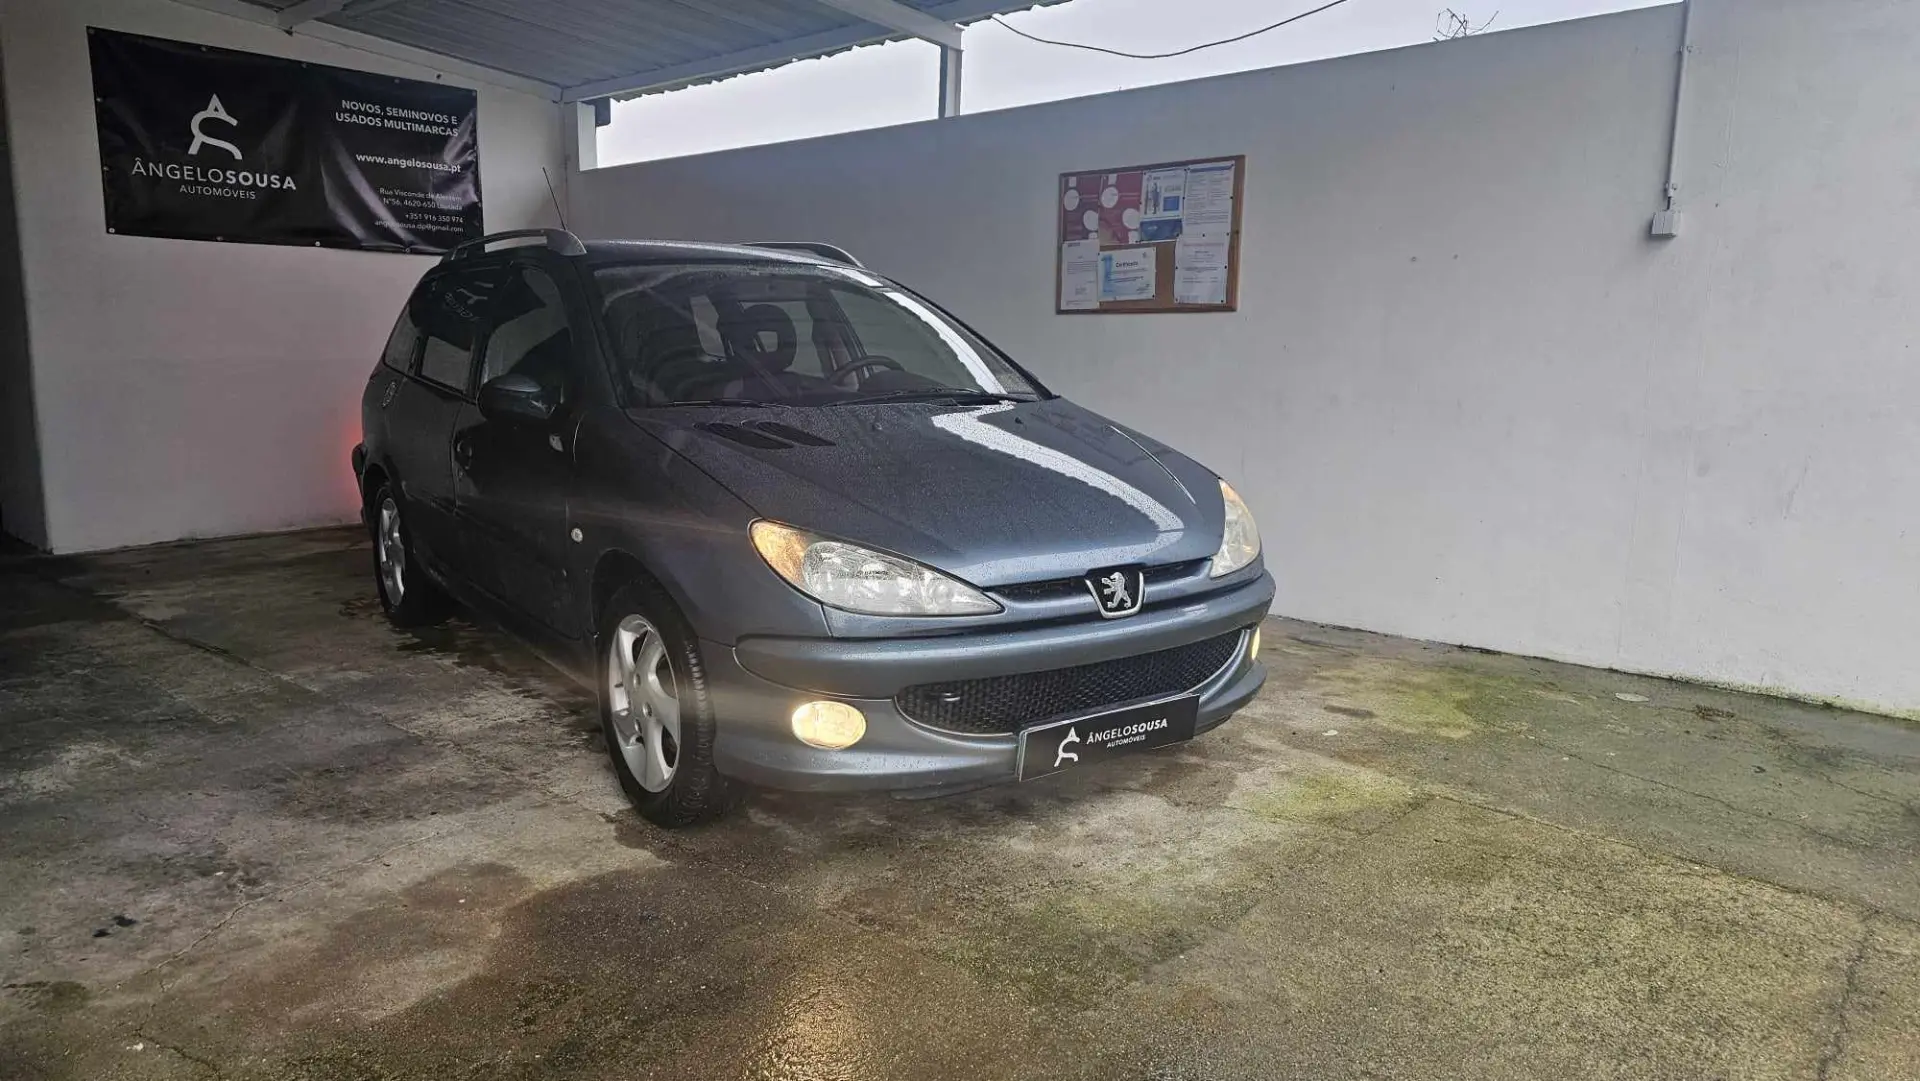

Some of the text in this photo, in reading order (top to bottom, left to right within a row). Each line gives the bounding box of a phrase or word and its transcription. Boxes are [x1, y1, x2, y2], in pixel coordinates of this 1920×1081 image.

[341, 100, 458, 125] NOVOS, SEMINOVOS E
[335, 112, 459, 137] USADOS MULTIMARCAS
[355, 153, 461, 173] www.angelosousa.pt
[179, 184, 256, 200] AUTOMÓVEIS
[379, 187, 393, 195] Rua
[405, 212, 422, 221] +351
[423, 213, 437, 222] 916
[1106, 734, 1147, 749] AUTOMÓVEIS
